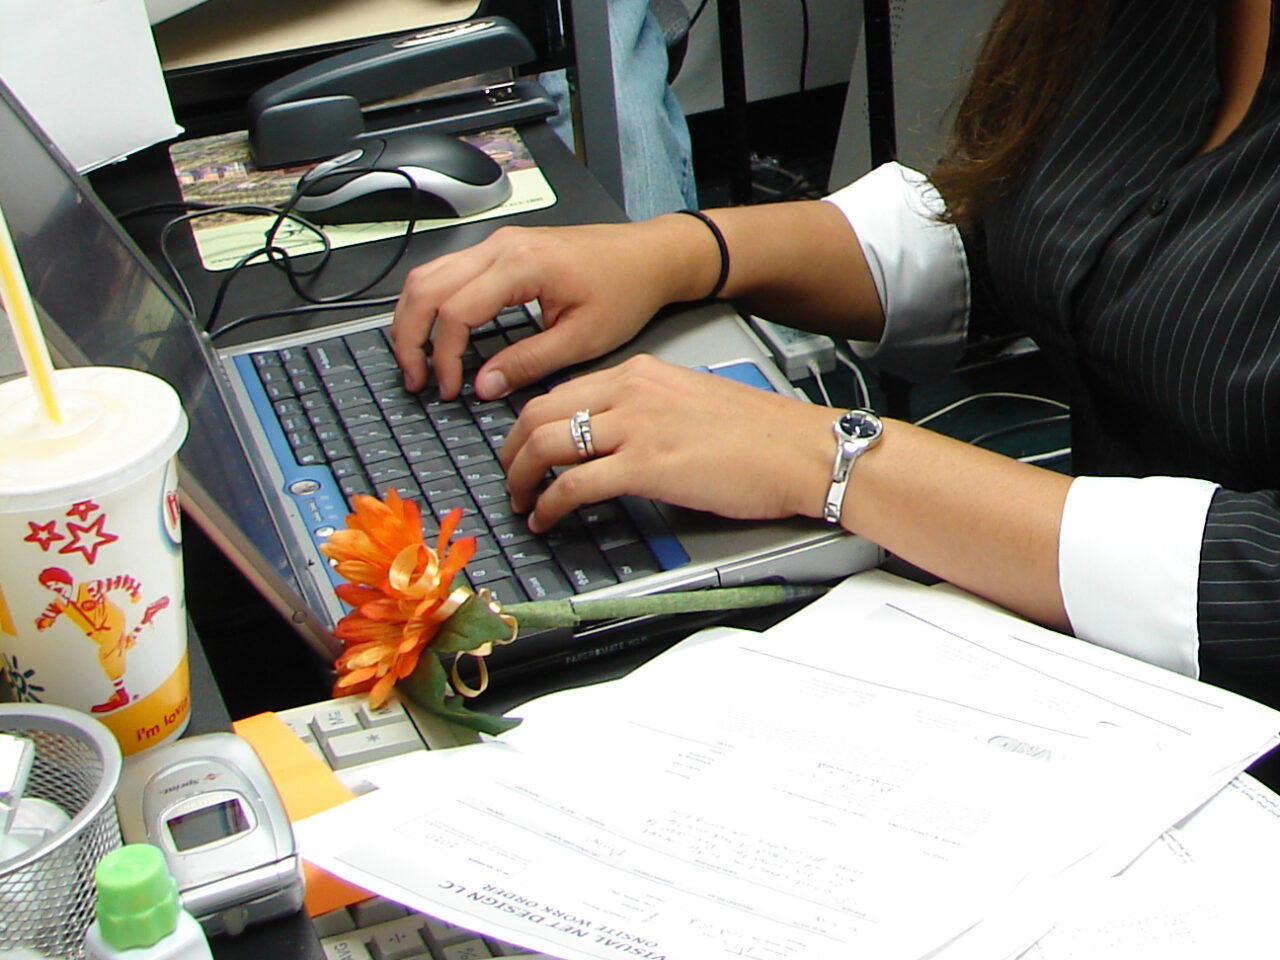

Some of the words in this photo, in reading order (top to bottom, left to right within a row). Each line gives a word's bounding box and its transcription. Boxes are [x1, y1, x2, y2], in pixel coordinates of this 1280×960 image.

[437, 880, 466, 895] LC
[482, 882, 543, 906] ORDER
[466, 890, 548, 926] DESIGN
[543, 904, 593, 927] WORK
[549, 921, 591, 939] NET
[595, 924, 660, 949] ONSITE
[593, 932, 668, 960] VISUAL
